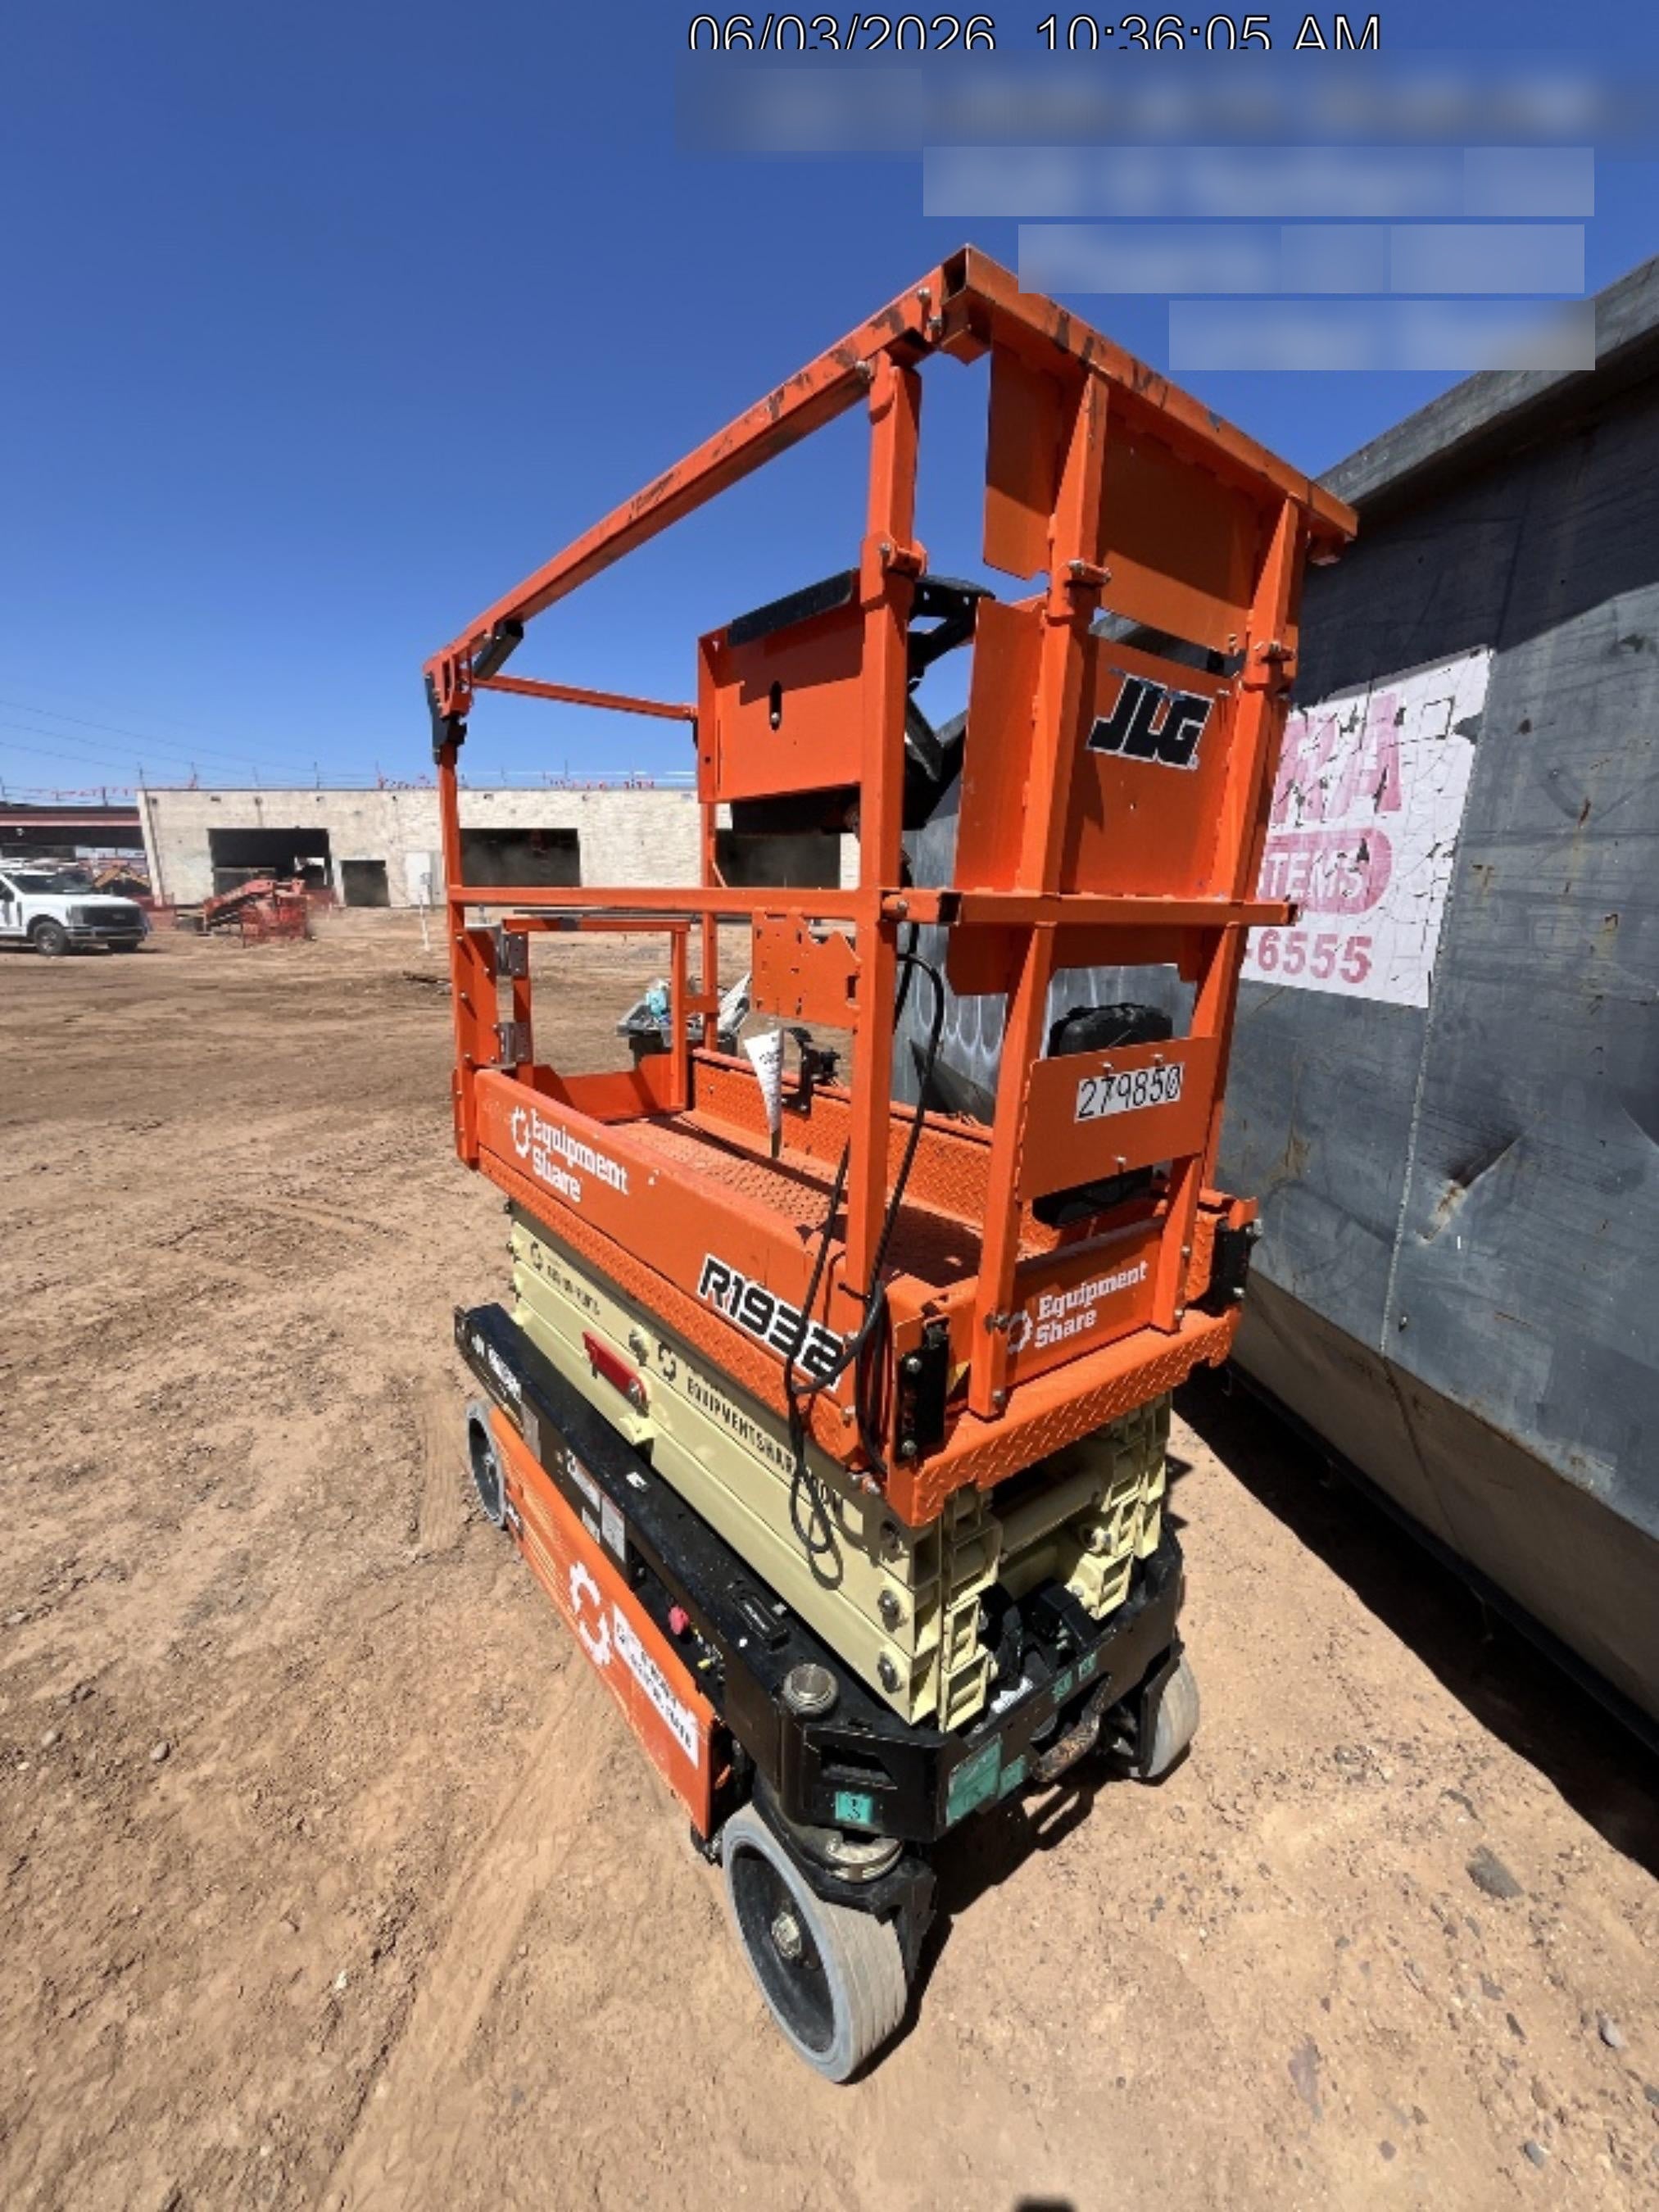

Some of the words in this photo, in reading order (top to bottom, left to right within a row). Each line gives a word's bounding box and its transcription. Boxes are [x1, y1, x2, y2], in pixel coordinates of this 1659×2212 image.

[1086, 673, 1214, 769] JLG
[1258, 847, 1370, 900] TEMS
[1078, 1065, 1181, 1118] 279850
[530, 1108, 628, 1195] Equipment
[533, 1145, 582, 1203] Share
[1037, 1260, 1149, 1321] Equipment
[697, 1253, 844, 1391] R1932
[1034, 1309, 1098, 1349] Share
